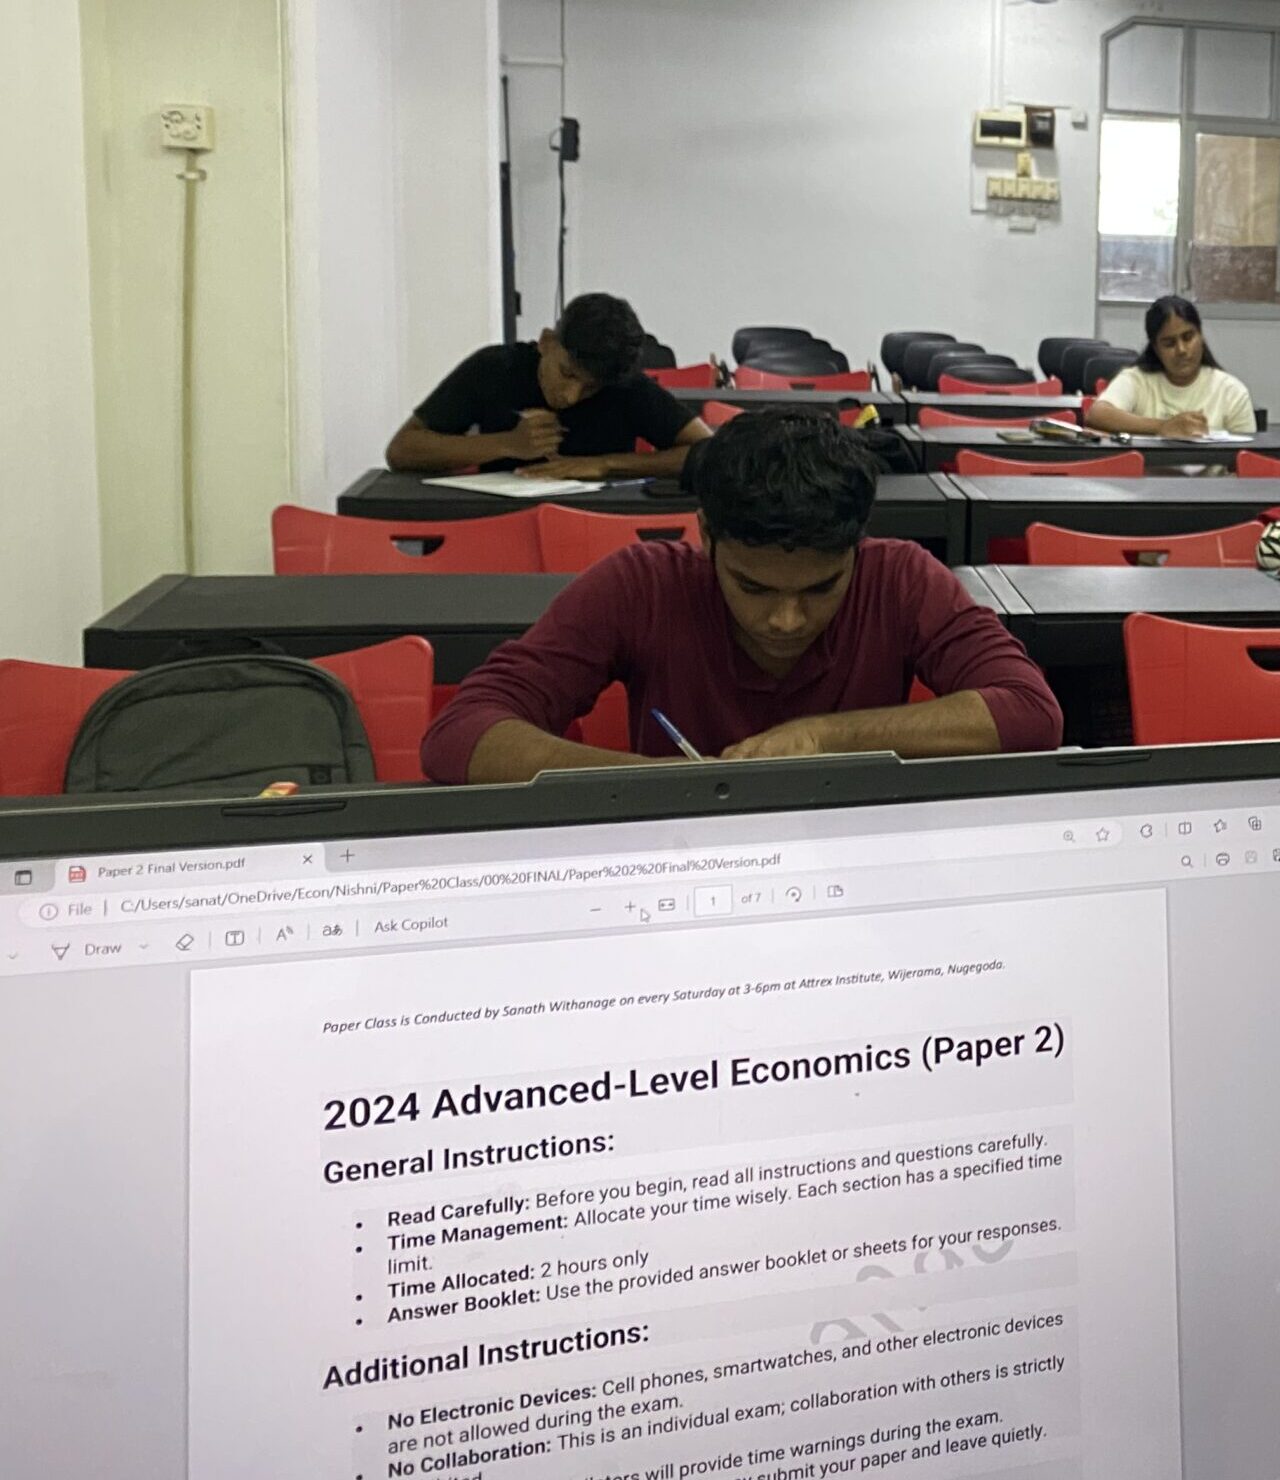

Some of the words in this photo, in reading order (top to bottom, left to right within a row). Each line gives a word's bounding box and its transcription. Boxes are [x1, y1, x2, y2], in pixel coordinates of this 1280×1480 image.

[98, 866, 133, 878] Paper
[135, 864, 144, 875] 2
[148, 861, 176, 874] Final
[179, 857, 246, 872] Version.pdf
[68, 903, 92, 916] File
[374, 919, 398, 933] Ask
[401, 916, 449, 933] Copilot
[741, 893, 752, 904] of
[755, 892, 762, 903] 7
[85, 942, 122, 956] Draw
[323, 1021, 361, 1034] Paper
[364, 1017, 397, 1030] Class
[400, 1015, 410, 1026] is
[414, 1008, 482, 1025] Conducted
[484, 1007, 500, 1020] by
[502, 1002, 545, 1017] Sanath
[549, 998, 616, 1012] Withanage
[619, 996, 635, 1006] on
[637, 994, 670, 1004] every
[672, 987, 726, 1001] Saturday
[728, 986, 741, 996] at
[743, 982, 781, 995] 3-6pm
[784, 980, 796, 990] at
[799, 978, 833, 988] Attrex
[835, 973, 884, 985] Institute,
[888, 967, 944, 981] Wijerama,
[947, 960, 1005, 975] Nugegoda.
[324, 1092, 420, 1130] 2024
[432, 1060, 718, 1119] Advanced-Level
[731, 1045, 910, 1086] Economics
[922, 1035, 1025, 1072] (Paper
[1035, 1023, 1064, 1058] 2)
[324, 1149, 433, 1184] General
[444, 1135, 613, 1170] Instructions:
[388, 1205, 435, 1227] Read
[441, 1196, 530, 1220] Carefully:
[536, 1189, 594, 1208] Before
[599, 1186, 630, 1204] you
[636, 1179, 687, 1197] begin,
[692, 1170, 729, 1189] read
[735, 1167, 753, 1184] all
[759, 1158, 856, 1181] instructions
[861, 1151, 891, 1168] and
[895, 1144, 973, 1167] questions
[978, 1133, 1047, 1154] carefully.
[387, 1233, 436, 1251] Time
[442, 1215, 568, 1244] Management:
[574, 1206, 645, 1226] Allocate
[650, 1201, 688, 1221] your
[693, 1196, 731, 1211] time
[736, 1186, 791, 1205] wisely.
[798, 1180, 837, 1198] Each
[843, 1174, 901, 1192] section
[906, 1170, 934, 1184] has
[939, 1169, 948, 1180] a
[954, 1156, 1023, 1180] specified
[1028, 1154, 1062, 1169] time
[387, 1302, 459, 1323] Answer
[465, 1289, 540, 1312] Booklet:
[546, 1284, 580, 1300] Use
[585, 1278, 613, 1295] the
[619, 1265, 693, 1294] provided
[699, 1260, 760, 1279] answer
[766, 1249, 827, 1270] booklet
[832, 1248, 848, 1261] or
[854, 1240, 907, 1258] sheets
[912, 1235, 933, 1250] for
[939, 1231, 972, 1250] your
[977, 1220, 1061, 1241] responses.
[388, 1255, 432, 1275] limit.
[388, 1281, 436, 1298] Time
[441, 1264, 534, 1292] Allocated:
[541, 1262, 551, 1278] 2
[558, 1258, 607, 1275] hours
[613, 1250, 648, 1268] only
[323, 1345, 468, 1389] Additional
[479, 1325, 648, 1366] Instructions:
[388, 1413, 415, 1430] No
[420, 1397, 514, 1425] Electronic
[520, 1386, 596, 1409] Devices:
[602, 1376, 635, 1396] Cell
[640, 1369, 708, 1394] phones,
[714, 1349, 836, 1379] smartwatches,
[842, 1340, 871, 1359] and
[876, 1336, 918, 1353] other
[923, 1322, 1000, 1346] electronic
[1005, 1315, 1063, 1333] devices
[388, 1461, 415, 1478] No
[420, 1440, 551, 1473] Collaboration:
[557, 1432, 595, 1450] This
[601, 1428, 615, 1443] is
[621, 1426, 642, 1440] an
[648, 1407, 729, 1435] individual
[735, 1403, 785, 1421] exam;
[790, 1384, 897, 1412] collaboration
[902, 1375, 935, 1393] with
[940, 1369, 990, 1387] others
[996, 1365, 1008, 1378] is
[1013, 1355, 1064, 1376] strictly
[388, 1438, 418, 1454] are
[423, 1430, 453, 1448] not
[459, 1415, 530, 1443] allowed
[535, 1410, 592, 1430] during
[597, 1403, 626, 1420] the
[631, 1396, 683, 1415] exam.
[645, 1463, 674, 1480] will
[679, 1453, 743, 1480] provide
[747, 1448, 785, 1465] time
[790, 1434, 866, 1457] warnings
[870, 1425, 921, 1444] during
[926, 1418, 951, 1435] the
[956, 1412, 1003, 1429] exam.
[819, 1458, 856, 1480] your
[861, 1449, 907, 1472] paper
[911, 1440, 941, 1459] and
[946, 1436, 987, 1453] leave
[991, 1424, 1046, 1448] quietly.
